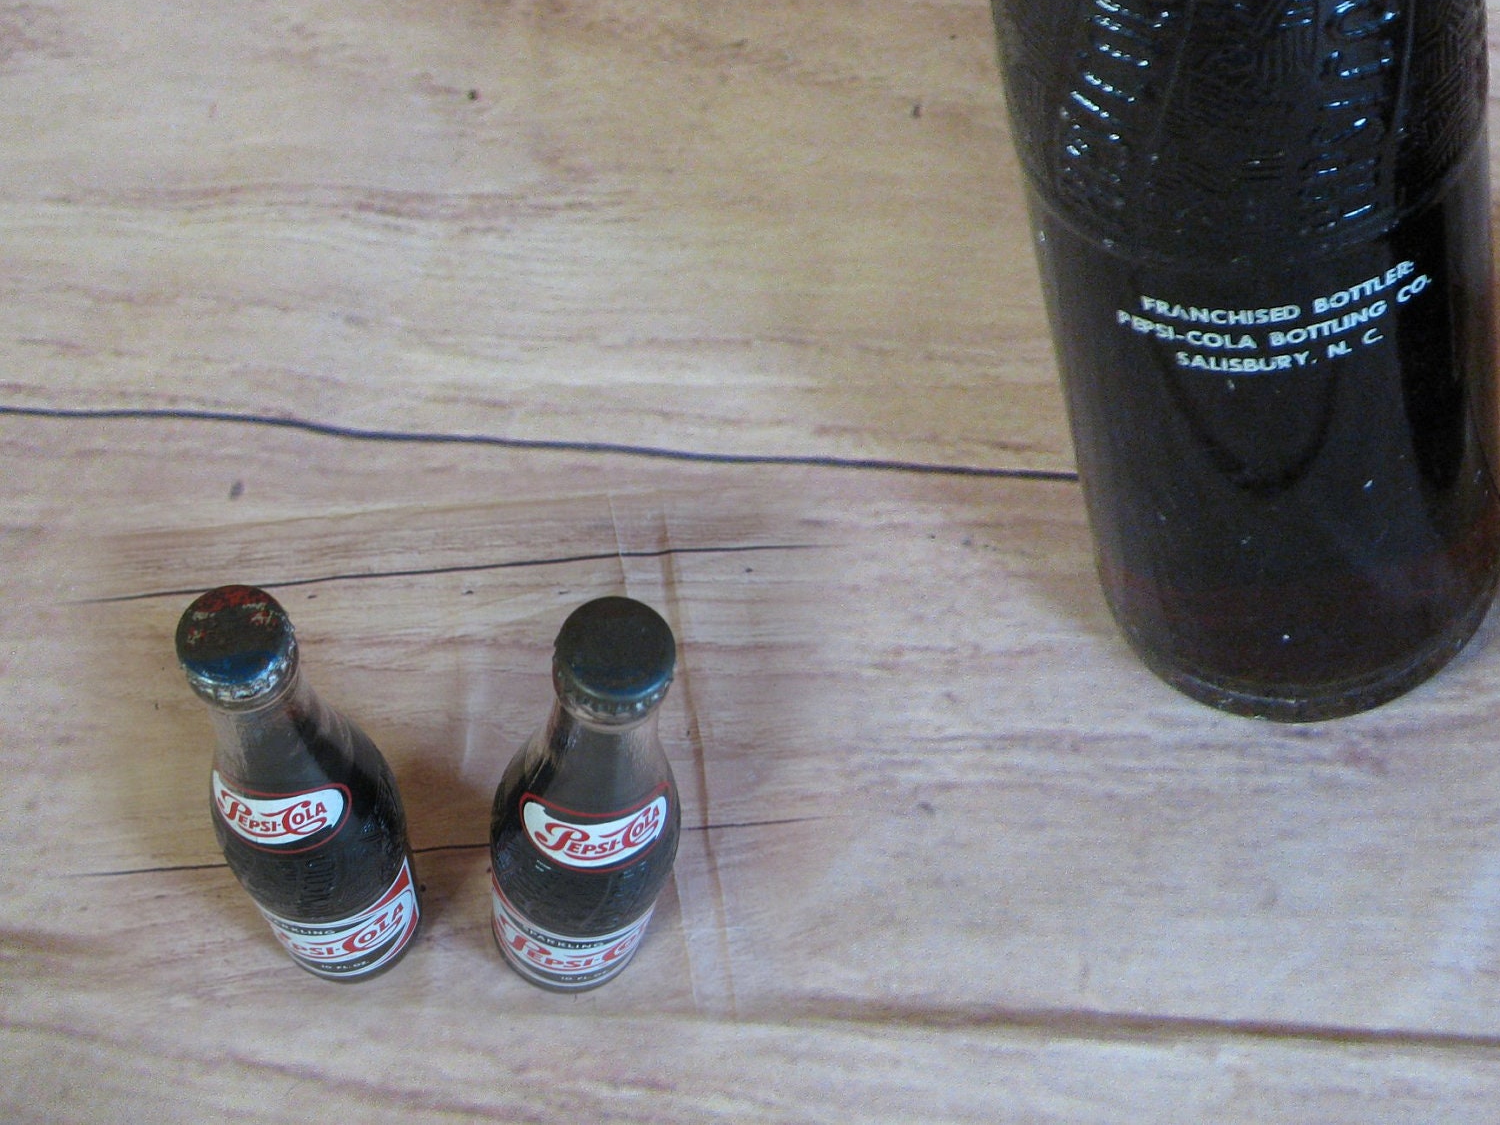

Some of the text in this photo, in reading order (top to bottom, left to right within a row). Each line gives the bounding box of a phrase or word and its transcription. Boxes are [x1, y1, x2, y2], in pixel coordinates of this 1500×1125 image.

[1116, 309, 1258, 351] PEPSI-COLA
[1267, 300, 1388, 348] BOTTLING
[1139, 294, 1301, 326] FRANCHISED
[217, 790, 328, 838] PEPSI-COLA
[534, 805, 660, 861] PEPSI-COLA
